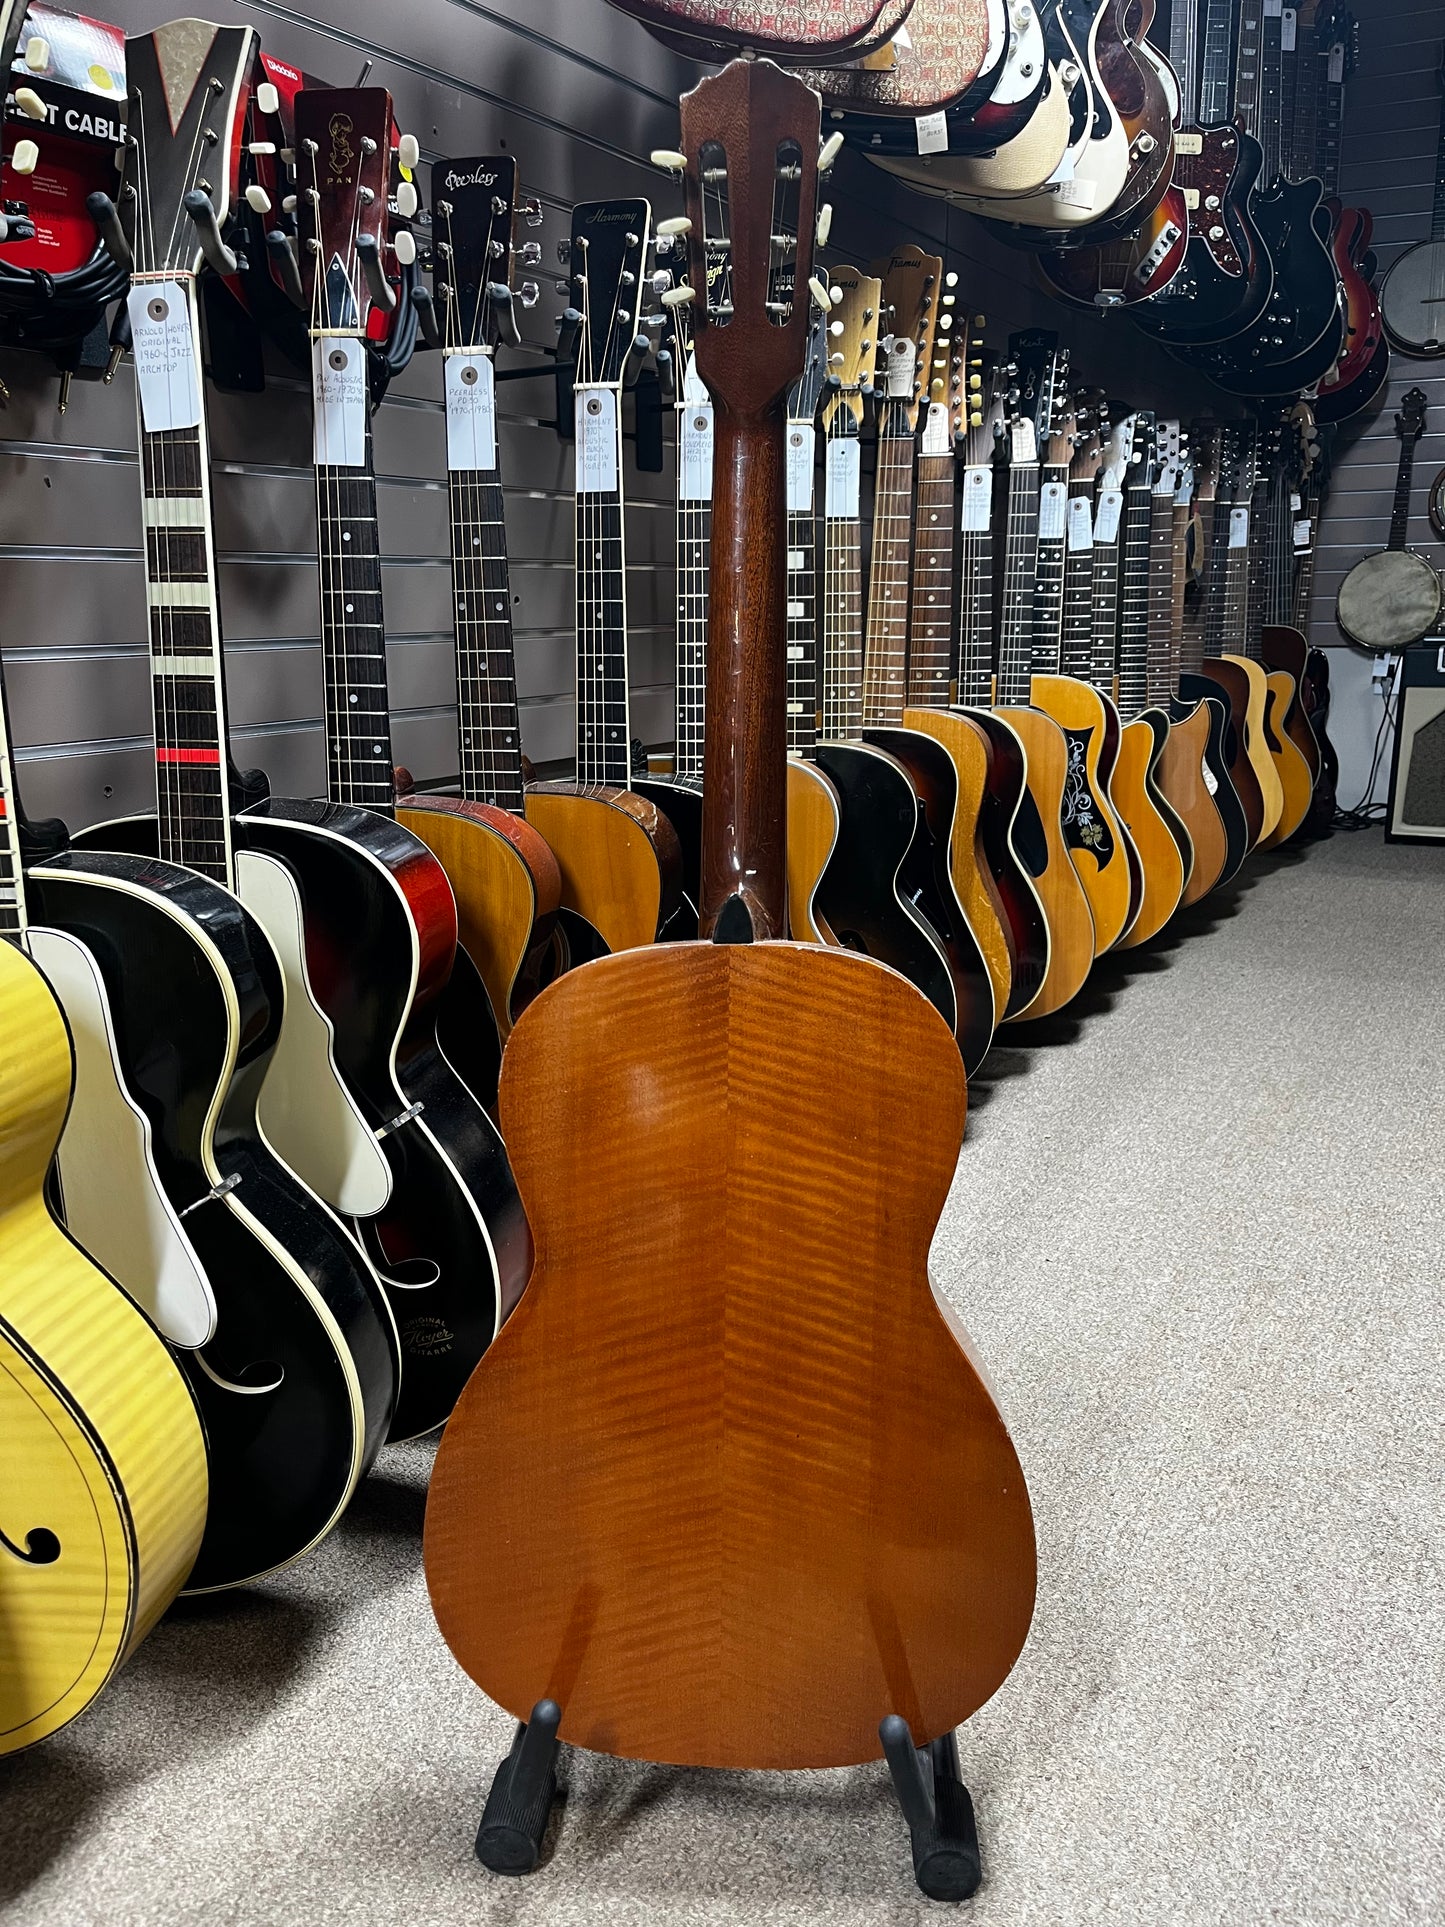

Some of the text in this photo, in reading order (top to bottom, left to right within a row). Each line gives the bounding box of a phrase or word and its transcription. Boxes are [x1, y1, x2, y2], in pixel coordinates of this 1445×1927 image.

[327, 176, 352, 185] PAN
[445, 164, 499, 191] Peerless
[585, 208, 638, 225] Harmony
[887, 256, 922, 274] Framus
[134, 327, 164, 337] ARNOLD
[170, 346, 191, 358] JAZZ
[449, 388, 488, 396] PEERLESS
[410, 1343, 453, 1356] GITARRE
